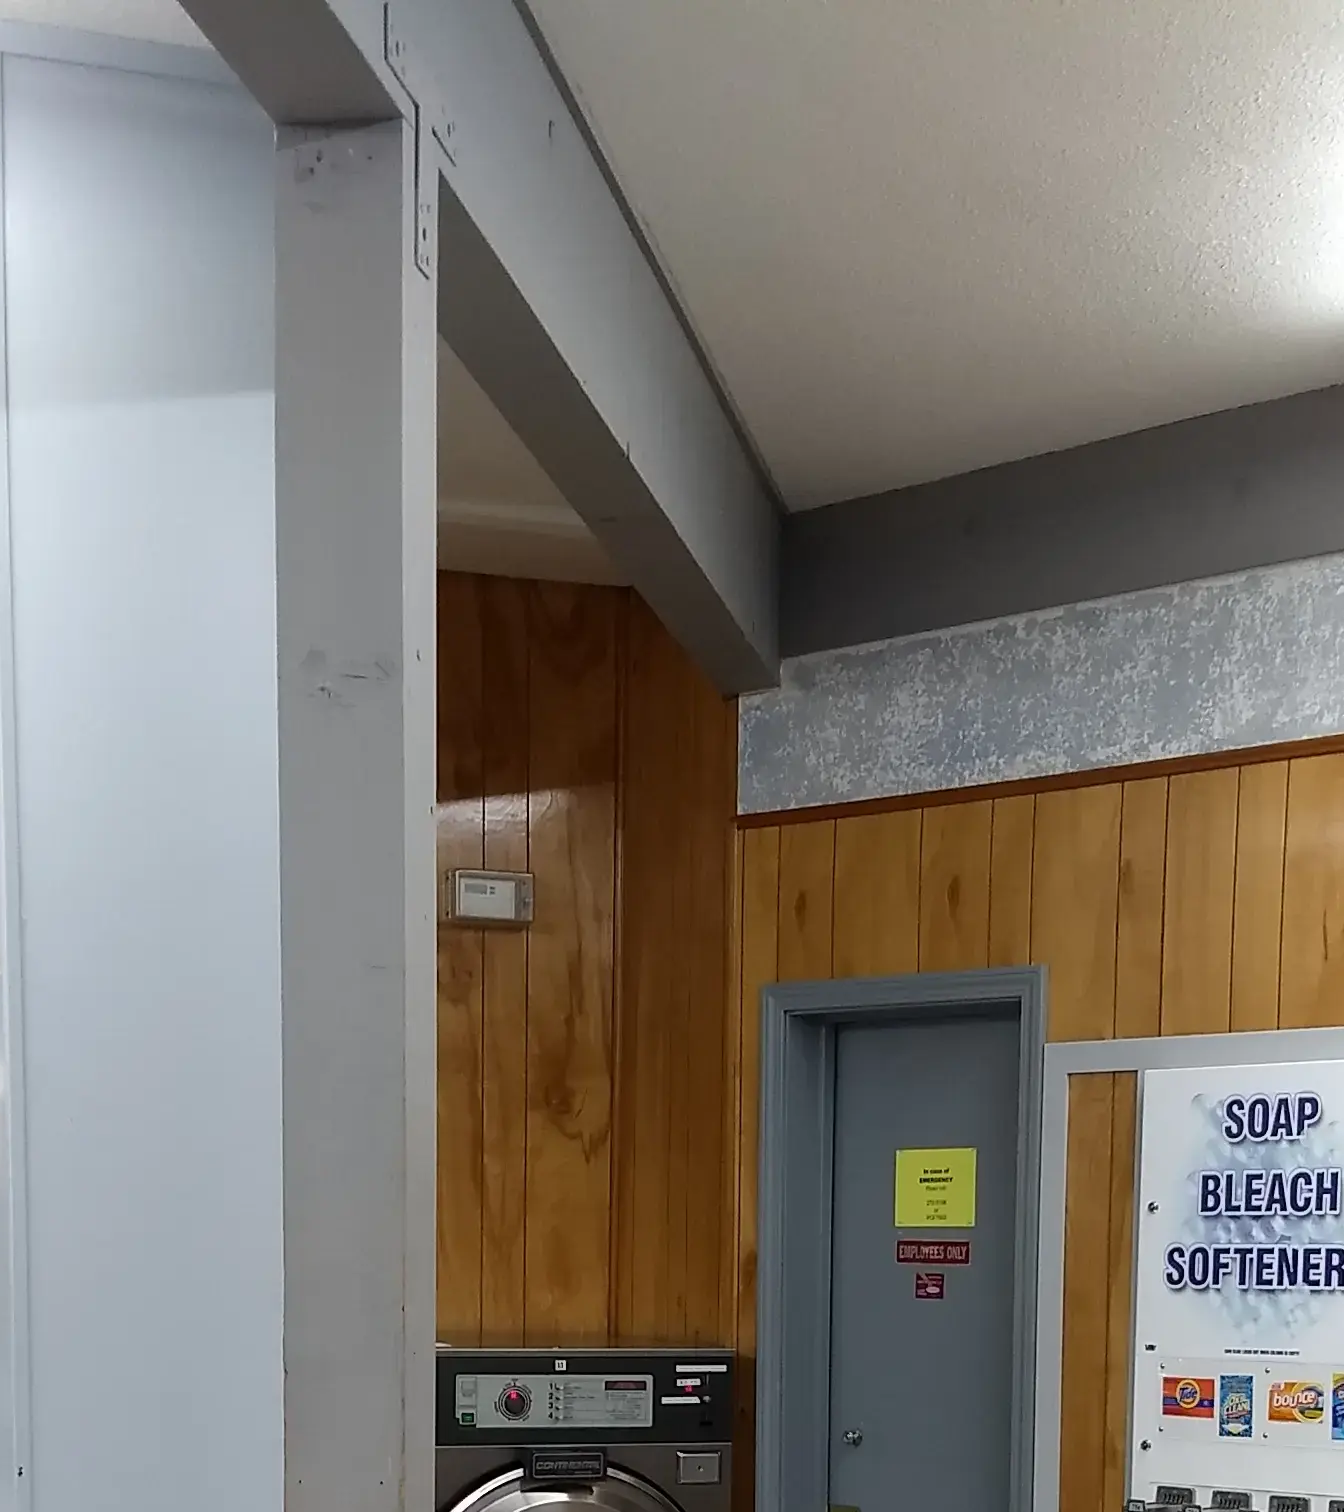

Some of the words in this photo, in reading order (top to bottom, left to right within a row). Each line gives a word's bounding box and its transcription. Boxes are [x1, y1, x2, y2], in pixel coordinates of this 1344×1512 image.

[1224, 1096, 1319, 1138] SOAP
[1200, 1171, 1340, 1213] BLEACH
[899, 1245, 944, 1260] EMPLOYEES
[946, 1246, 967, 1260] ONLY
[548, 1392, 554, 1400] 2
[1179, 1387, 1198, 1402] Tide
[1274, 1392, 1316, 1406] bounce
